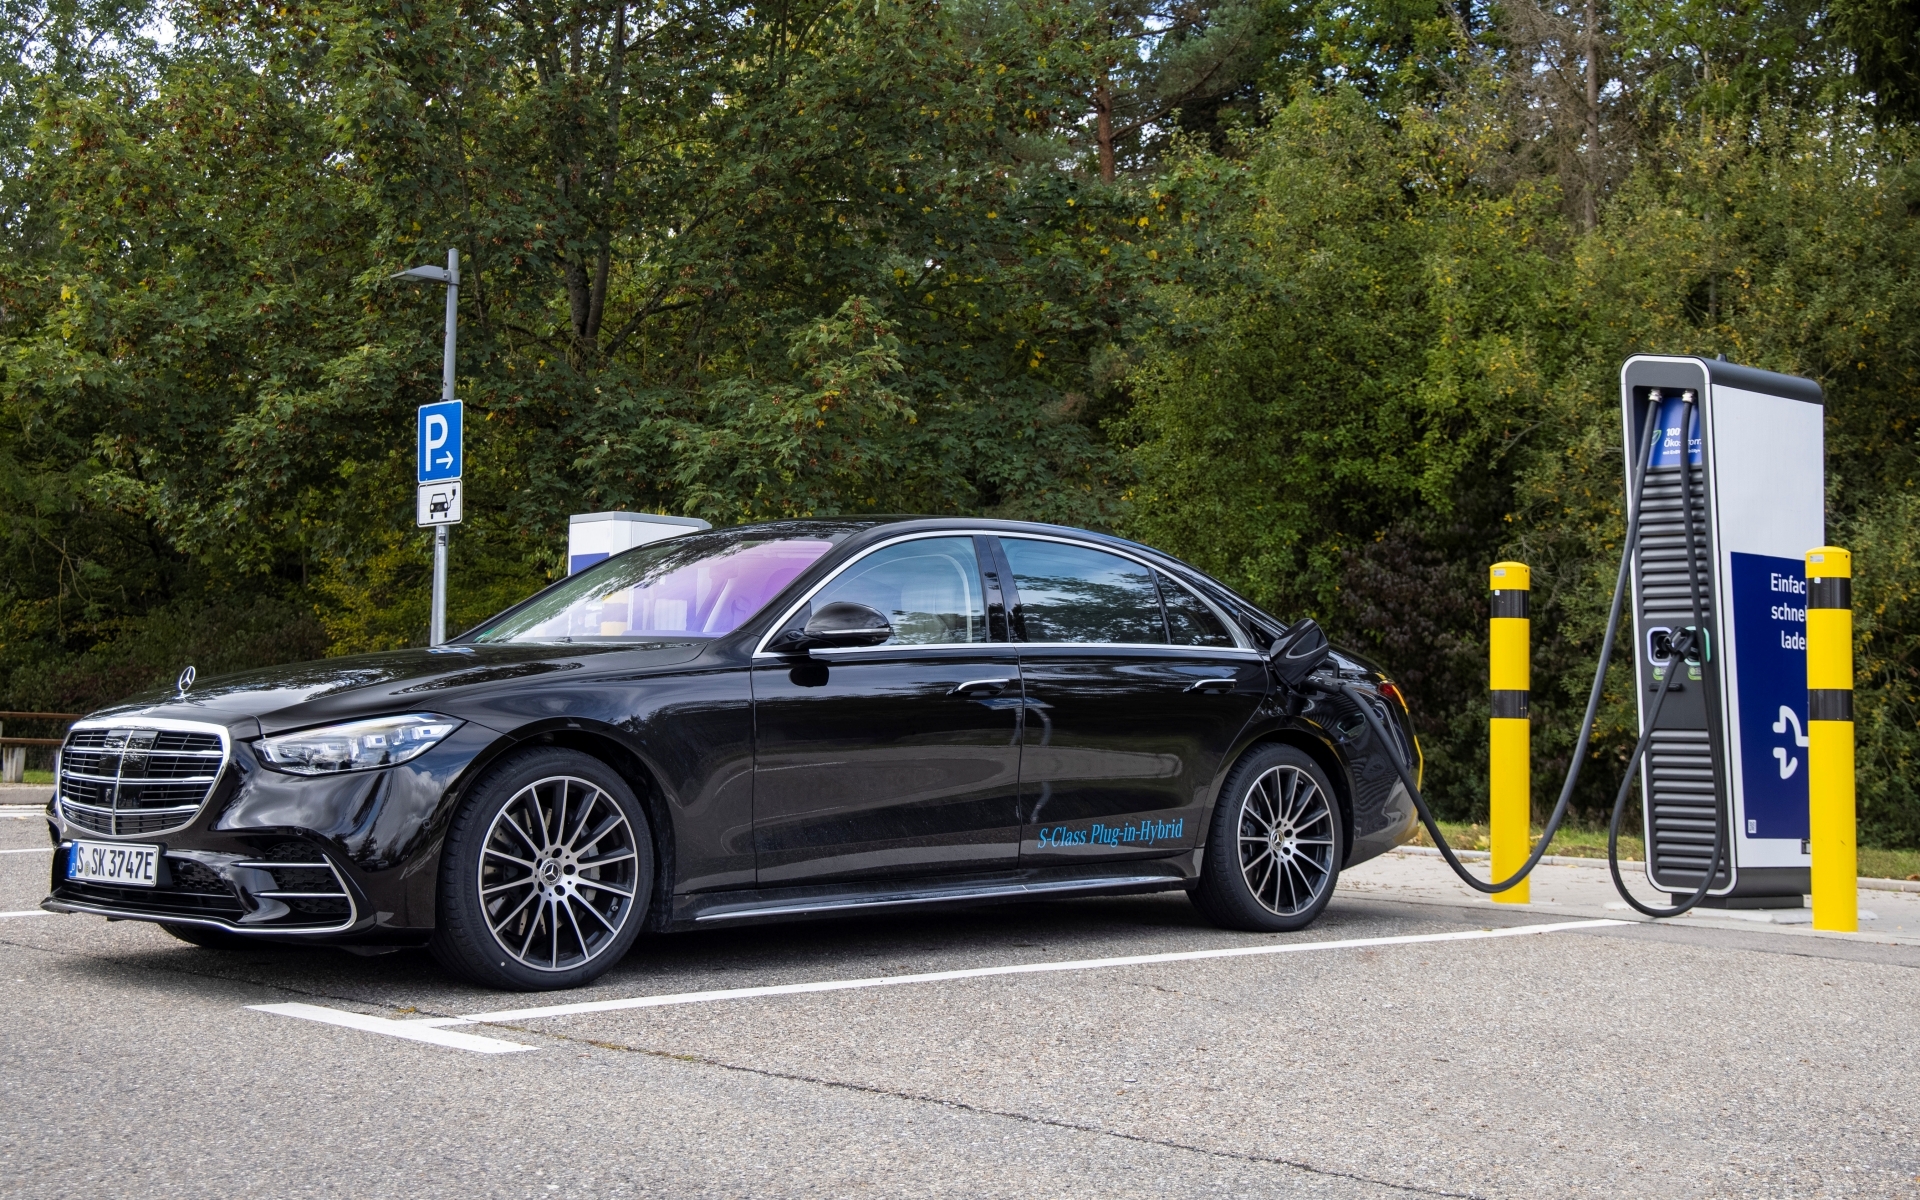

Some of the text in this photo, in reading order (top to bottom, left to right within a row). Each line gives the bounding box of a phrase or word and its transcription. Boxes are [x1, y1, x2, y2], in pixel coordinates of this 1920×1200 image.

[425, 413, 448, 472] P
[1770, 572, 1806, 594] Einfac
[1781, 630, 1806, 650] lade
[1037, 817, 1183, 849] S-Class Plug-in-Hybrid
[77, 846, 154, 880] S SK 3747E
